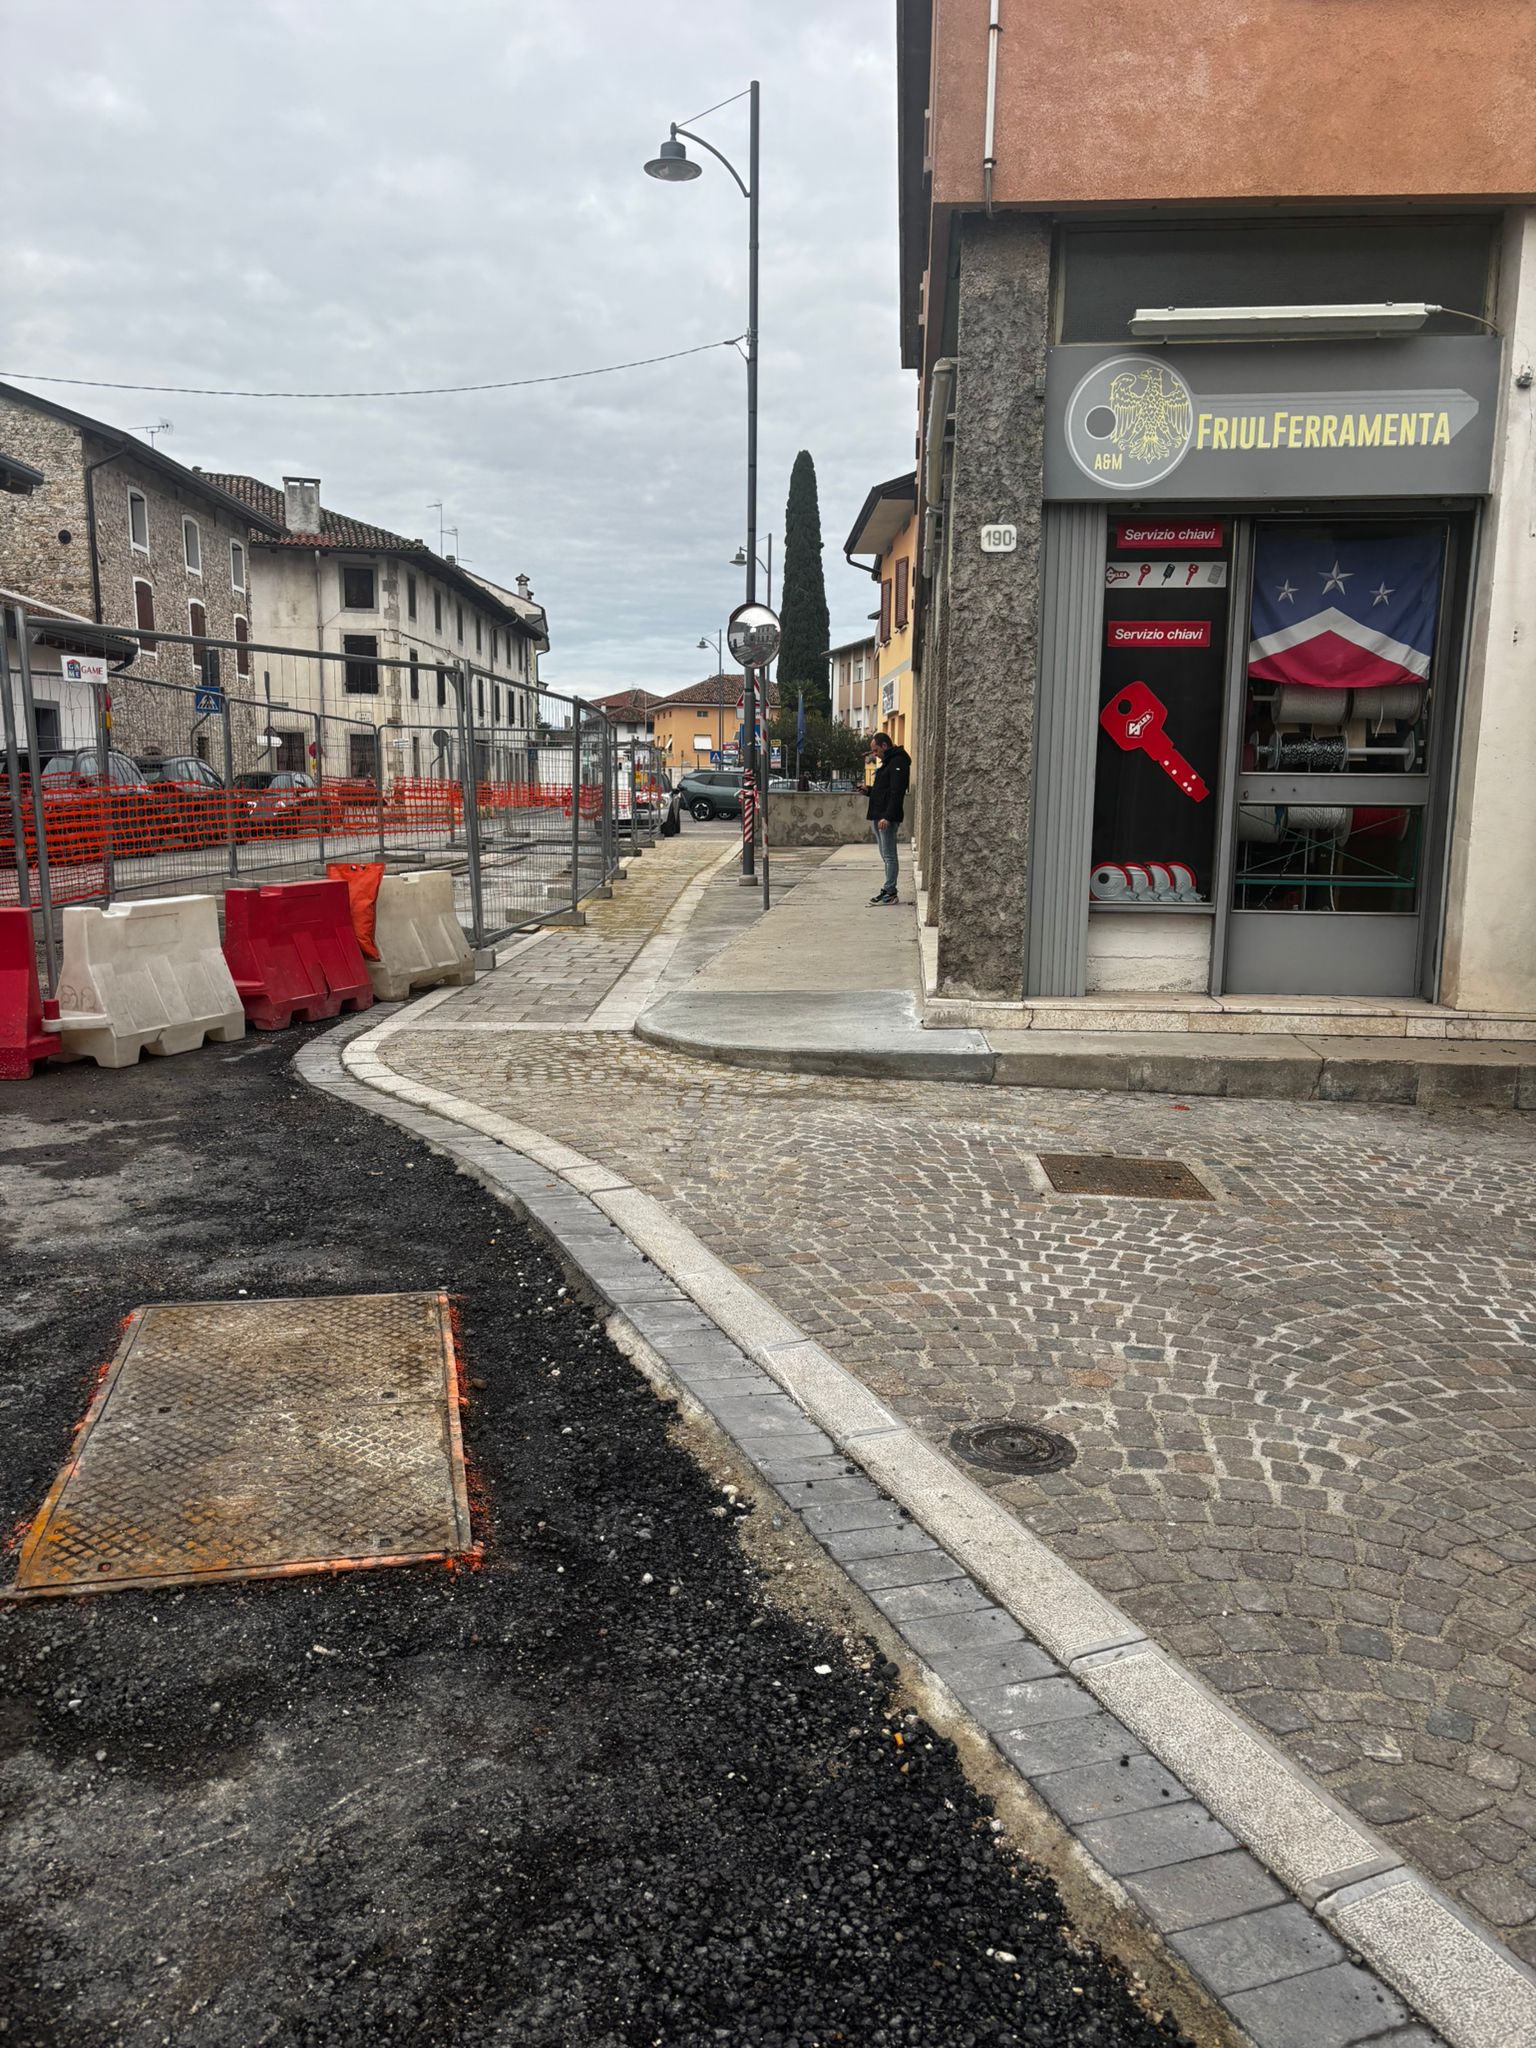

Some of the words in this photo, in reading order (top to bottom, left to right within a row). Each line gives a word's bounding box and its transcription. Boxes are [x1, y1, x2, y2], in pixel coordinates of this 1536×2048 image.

[1094, 453, 1123, 470] A&M
[985, 530, 1012, 547] 190
[1124, 528, 1175, 541] Servizio
[1178, 528, 1216, 540] chiavi
[1115, 628, 1164, 640] Servizio
[1166, 628, 1204, 640] chiavi
[81, 665, 104, 675] GAME
